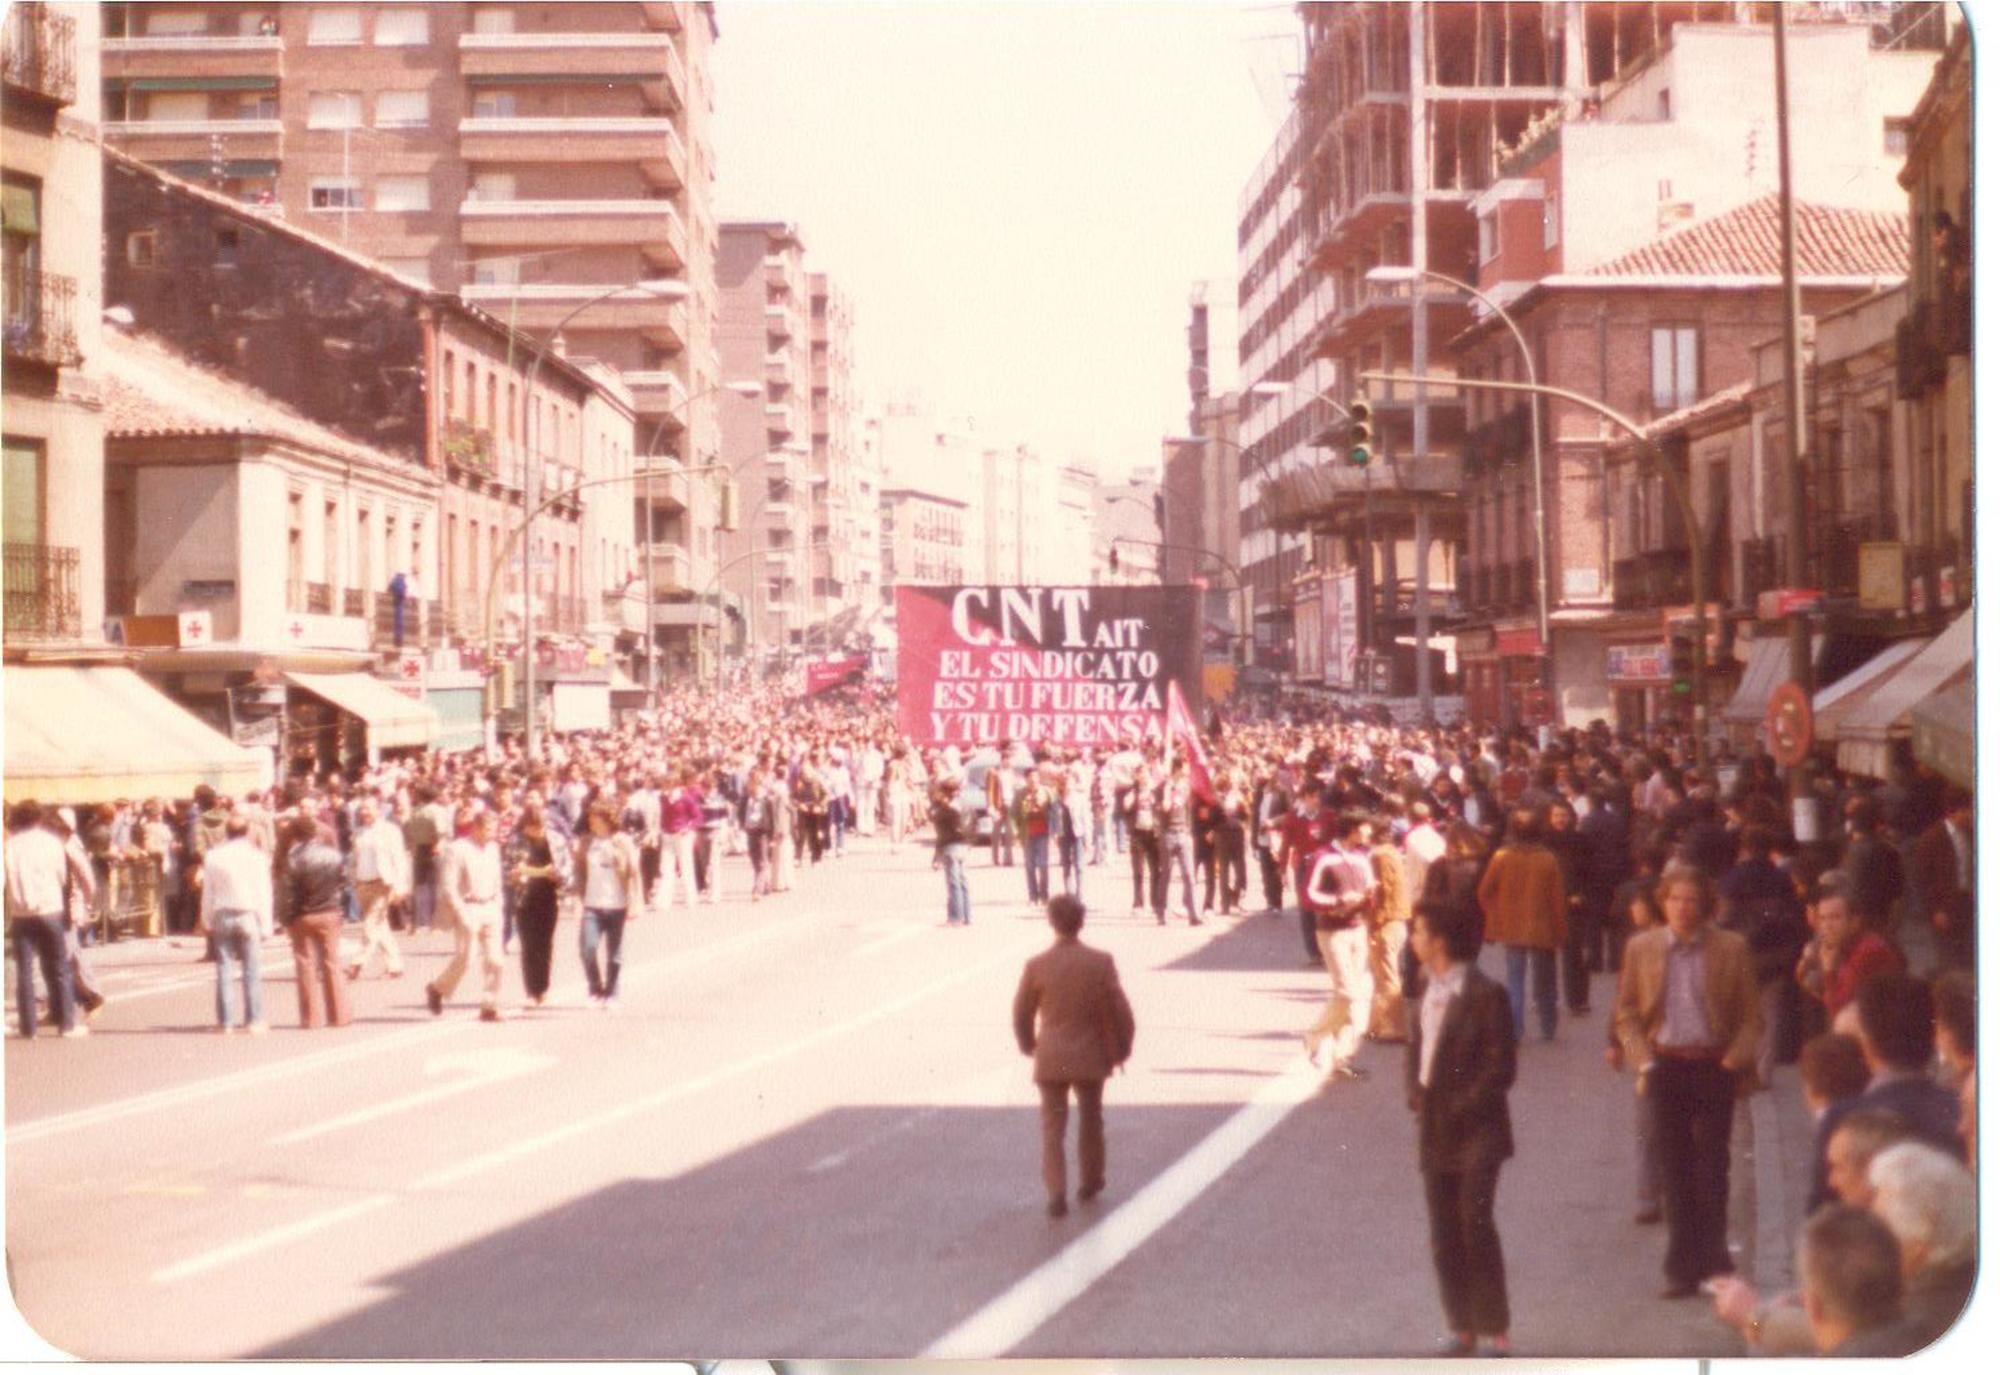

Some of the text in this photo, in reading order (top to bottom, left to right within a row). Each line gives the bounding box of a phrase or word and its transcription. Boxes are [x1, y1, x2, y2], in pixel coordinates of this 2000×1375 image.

[952, 587, 1144, 648] CNT AIT
[940, 651, 1159, 680] EL SINDICATO
[933, 681, 1162, 711] ES TU FUERZA
[929, 712, 1162, 742] Y TU DEFENSA
